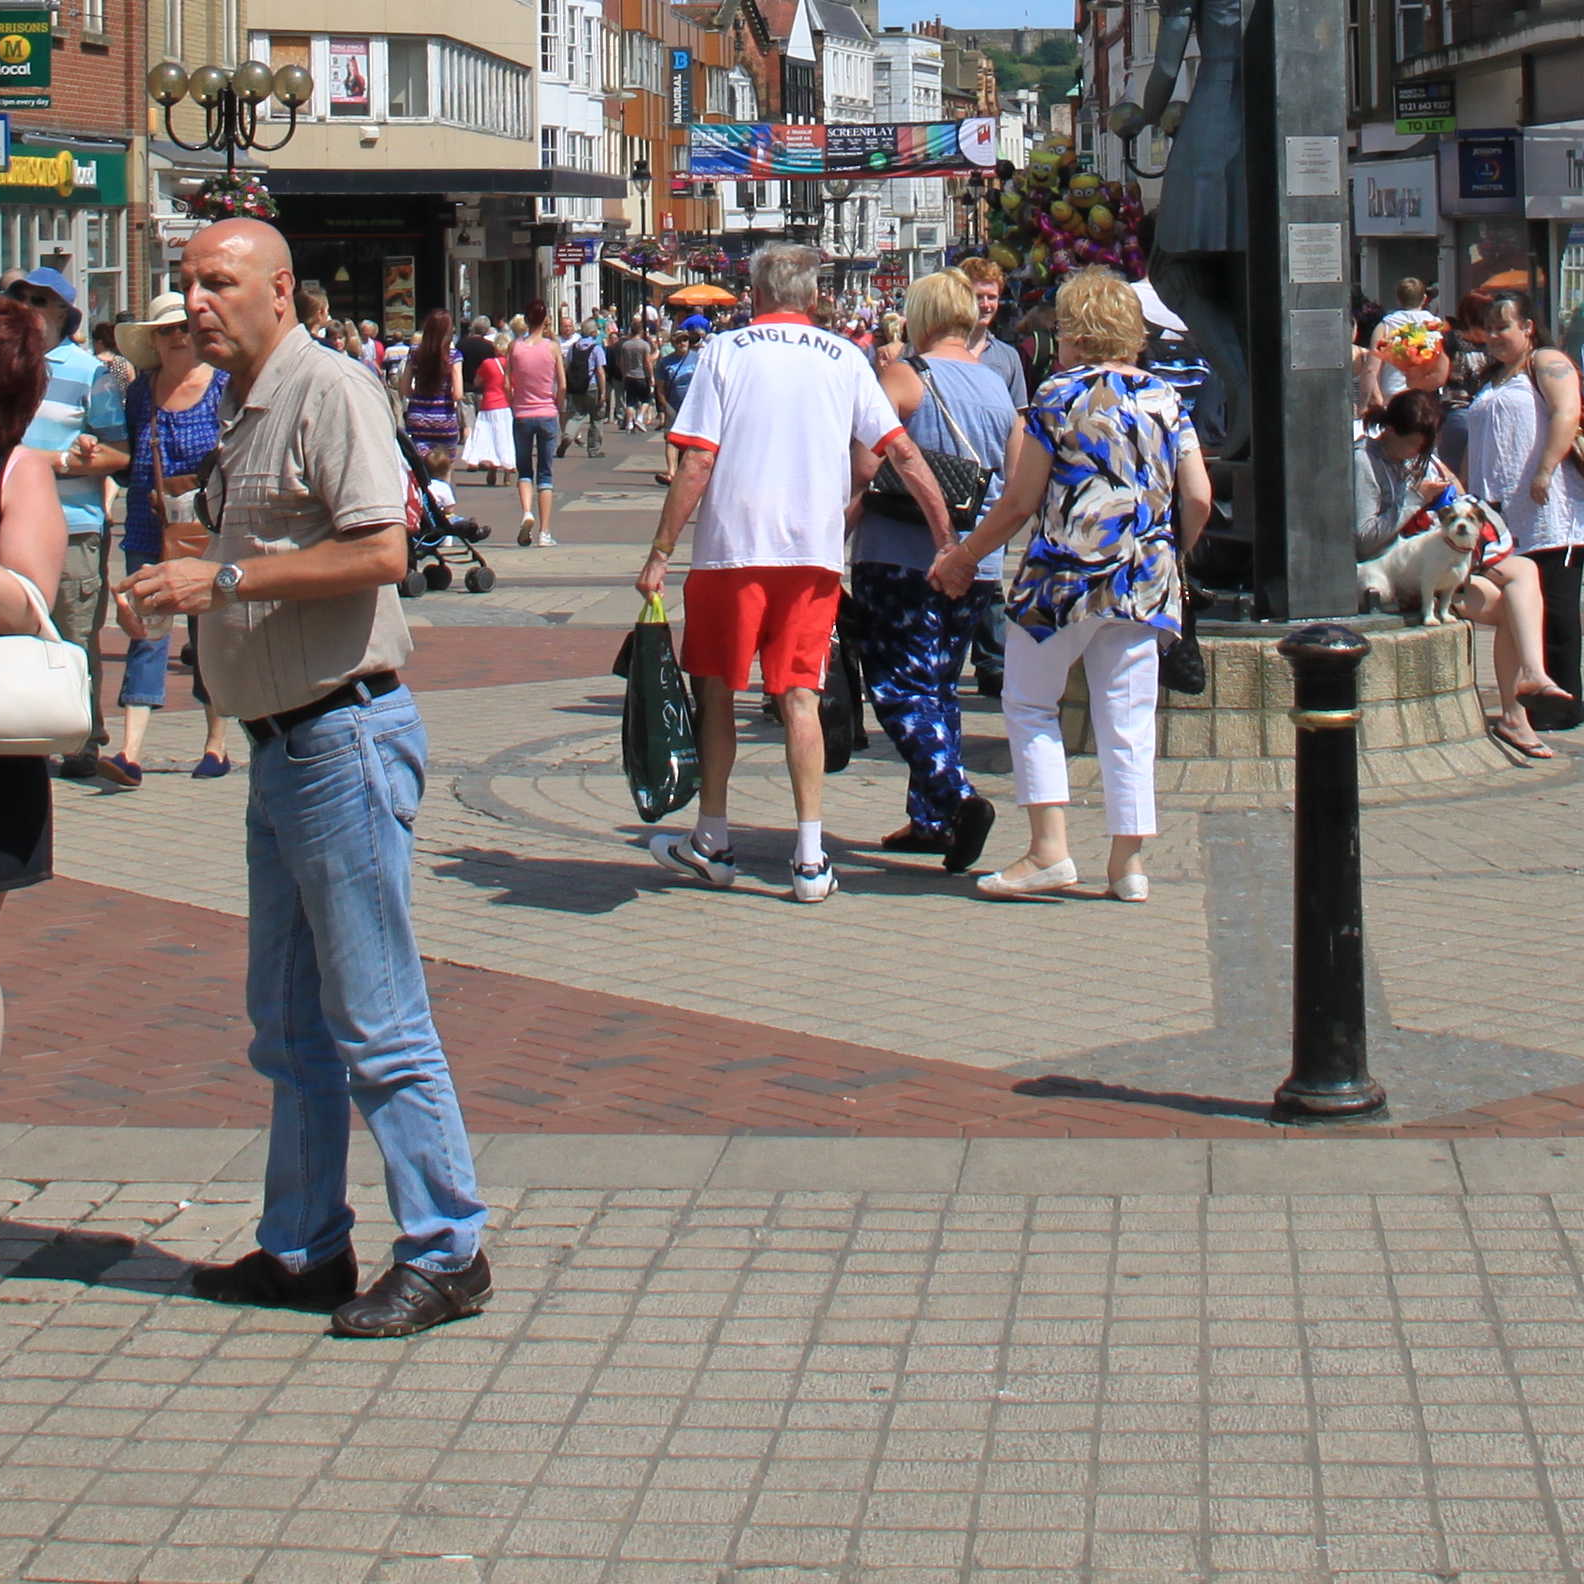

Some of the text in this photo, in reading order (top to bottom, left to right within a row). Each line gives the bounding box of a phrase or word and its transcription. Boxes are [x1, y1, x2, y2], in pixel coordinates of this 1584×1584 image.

[4, 40, 23, 58] M
[16, 100, 35, 108] every
[36, 98, 49, 108] day
[673, 73, 682, 124] BALMORAL
[1399, 102, 1416, 111] 0121
[1407, 120, 1444, 131] TO LET
[827, 127, 895, 137] SCREENPLAY
[1472, 147, 1502, 156] JESSOPS
[1484, 163, 1489, 172] 1
[886, 278, 908, 287] SALE
[732, 327, 843, 361] ENGLAND
